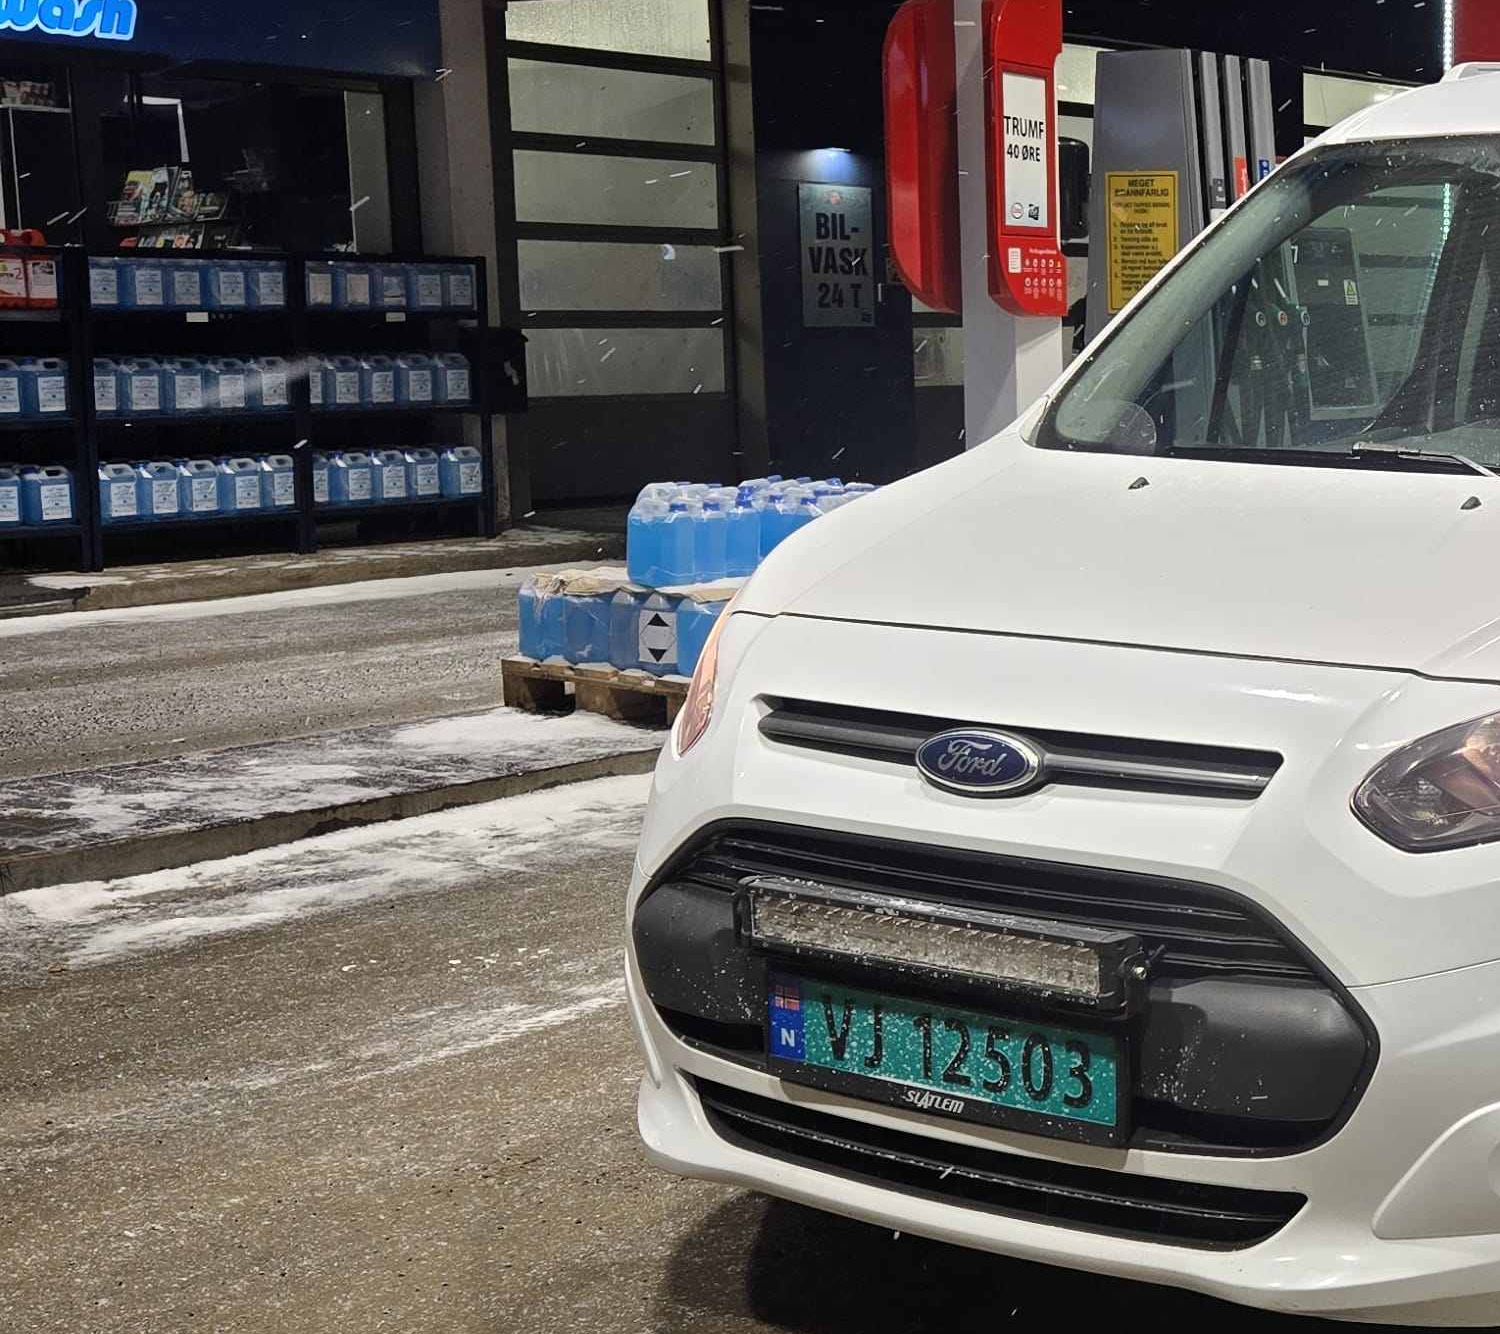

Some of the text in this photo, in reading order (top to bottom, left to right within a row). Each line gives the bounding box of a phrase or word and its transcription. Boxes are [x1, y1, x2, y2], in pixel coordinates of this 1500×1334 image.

[1003, 115, 1045, 140] TRUMF
[1006, 143, 1041, 162] 40 ØRE
[1128, 179, 1155, 188] MEGET
[815, 212, 860, 241] BIL-
[808, 246, 869, 276] VASK
[1290, 245, 1299, 264] 7
[817, 282, 862, 309] 24 T
[937, 738, 1008, 777] Ford
[780, 1028, 795, 1048] N
[821, 993, 1093, 1109] VJ 12503
